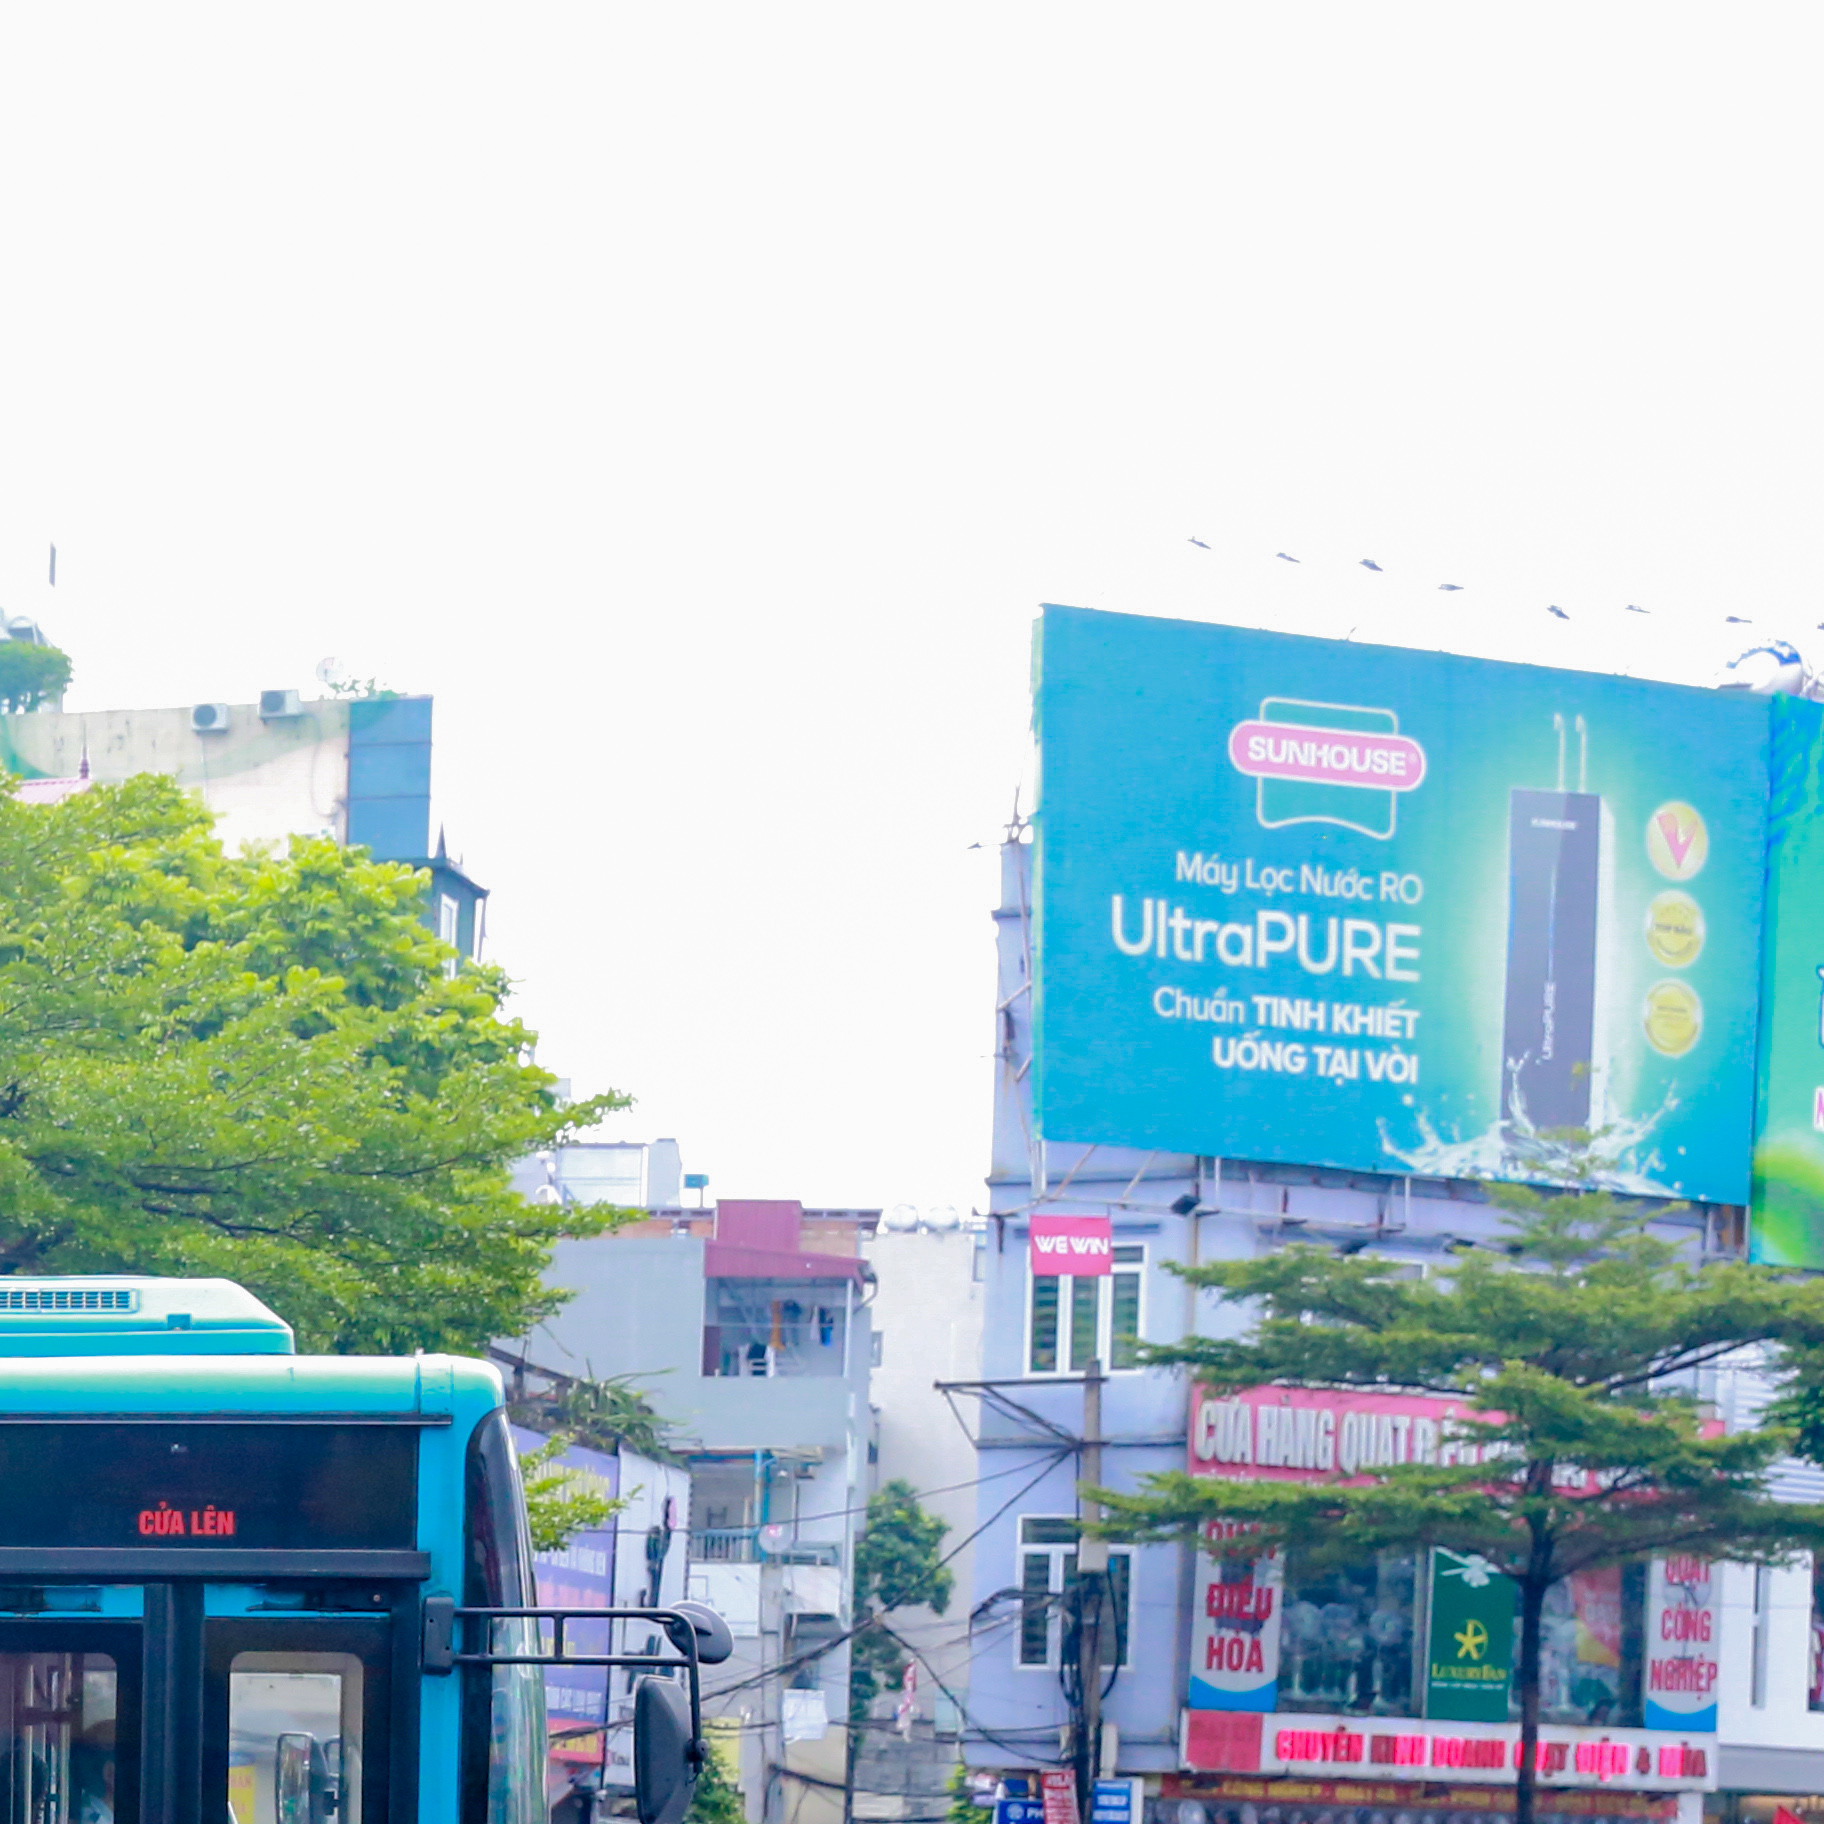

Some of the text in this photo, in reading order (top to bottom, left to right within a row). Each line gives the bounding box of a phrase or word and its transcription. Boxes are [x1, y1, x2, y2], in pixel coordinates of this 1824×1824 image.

[1248, 734, 1407, 778] SUNHOUSE
[1175, 851, 1424, 905] Máy Lọc Nước RO
[1110, 894, 1423, 983] UltraPURE
[1153, 985, 1421, 1040] Chuẩn TINH KHIẾT
[1212, 1030, 1420, 1087] UỐNG TẠI VÒI
[1034, 1235, 1109, 1255] WE WIN
[138, 1501, 235, 1535] CỬA LÊN
